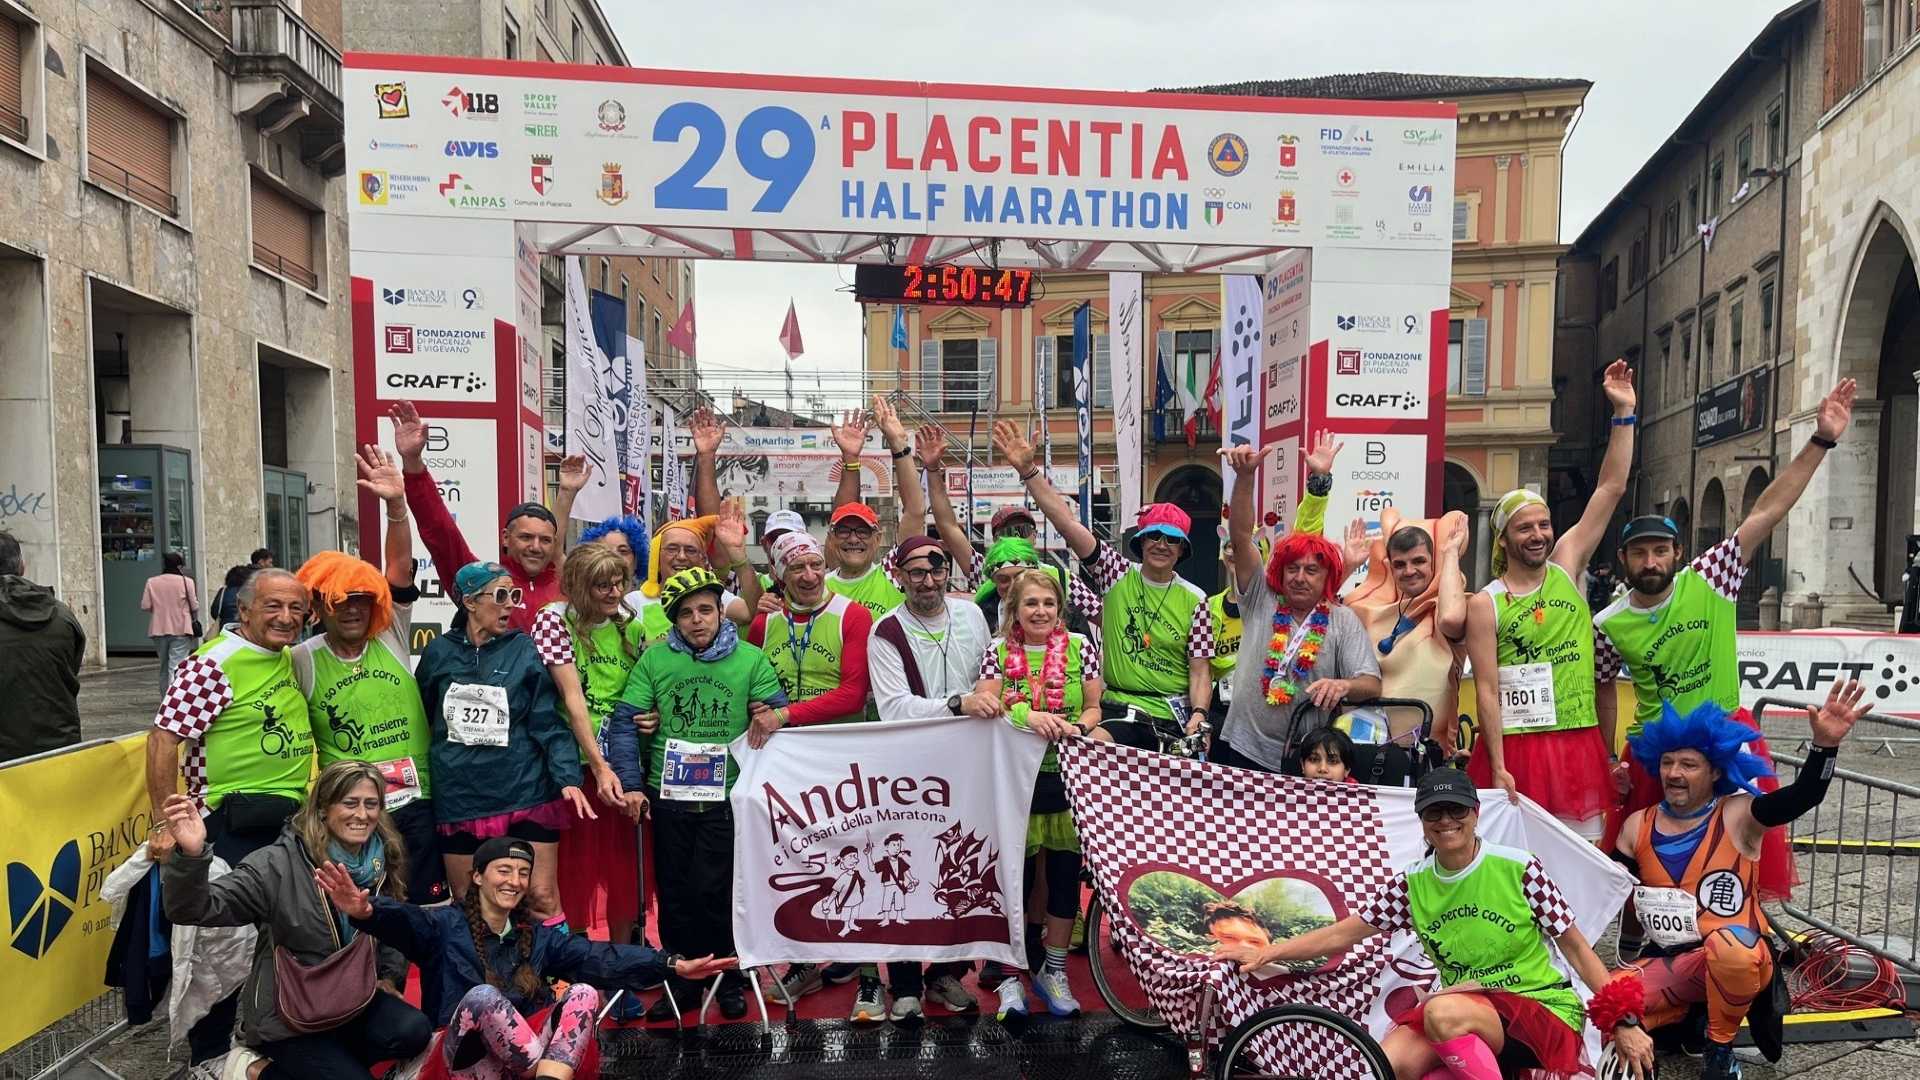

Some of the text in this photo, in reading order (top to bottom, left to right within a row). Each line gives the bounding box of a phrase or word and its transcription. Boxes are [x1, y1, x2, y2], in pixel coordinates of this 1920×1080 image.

[466, 93, 499, 113] 118
[524, 102, 558, 110] VALLEY
[537, 125, 559, 137] RER
[445, 141, 499, 159] AVIS
[842, 110, 1189, 181] PLACENTIA
[460, 196, 506, 208] ANPAS
[842, 180, 1188, 230] HALF MARATHON
[1226, 201, 1252, 210] CONI
[904, 265, 1032, 302] 2:50:47
[417, 329, 486, 339] FONDAZIONE
[428, 338, 472, 346] PIACENZA
[424, 345, 471, 354] VIGEVANO
[1364, 353, 1422, 361] FONDAZIONE
[1370, 367, 1408, 375] VIGEVANO
[386, 373, 465, 389] CRAFT
[1268, 400, 1291, 418] CRAFT
[1336, 393, 1402, 408] CRAFT
[1351, 471, 1400, 481] BOSSONI
[864, 600, 887, 615] corro
[1549, 599, 1577, 613] corro
[1163, 620, 1181, 641] corro
[1652, 621, 1685, 651] perchè
[771, 647, 781, 658] so
[812, 641, 836, 664] corro
[1737, 648, 1766, 657] ecnico
[325, 687, 336, 700] so
[336, 668, 370, 690] perchè
[373, 669, 401, 686] corro
[1738, 661, 1873, 691] RAFT
[675, 681, 684, 691] so
[714, 680, 733, 697] corro
[1505, 689, 1536, 707] 1601
[462, 707, 489, 724] 327
[370, 717, 408, 735] insieme
[352, 730, 410, 755] al traguardo
[762, 763, 951, 846] Andrea
[88, 811, 155, 870] BANCA
[774, 808, 947, 867] e i Corsari della Maratona
[1705, 872, 1737, 912] 亀
[82, 919, 94, 936] 90
[1427, 920, 1441, 934] so
[1440, 903, 1479, 925] perchè
[1481, 909, 1517, 933] corro
[1646, 913, 1683, 932] 1600
[1469, 962, 1514, 980] insieme
